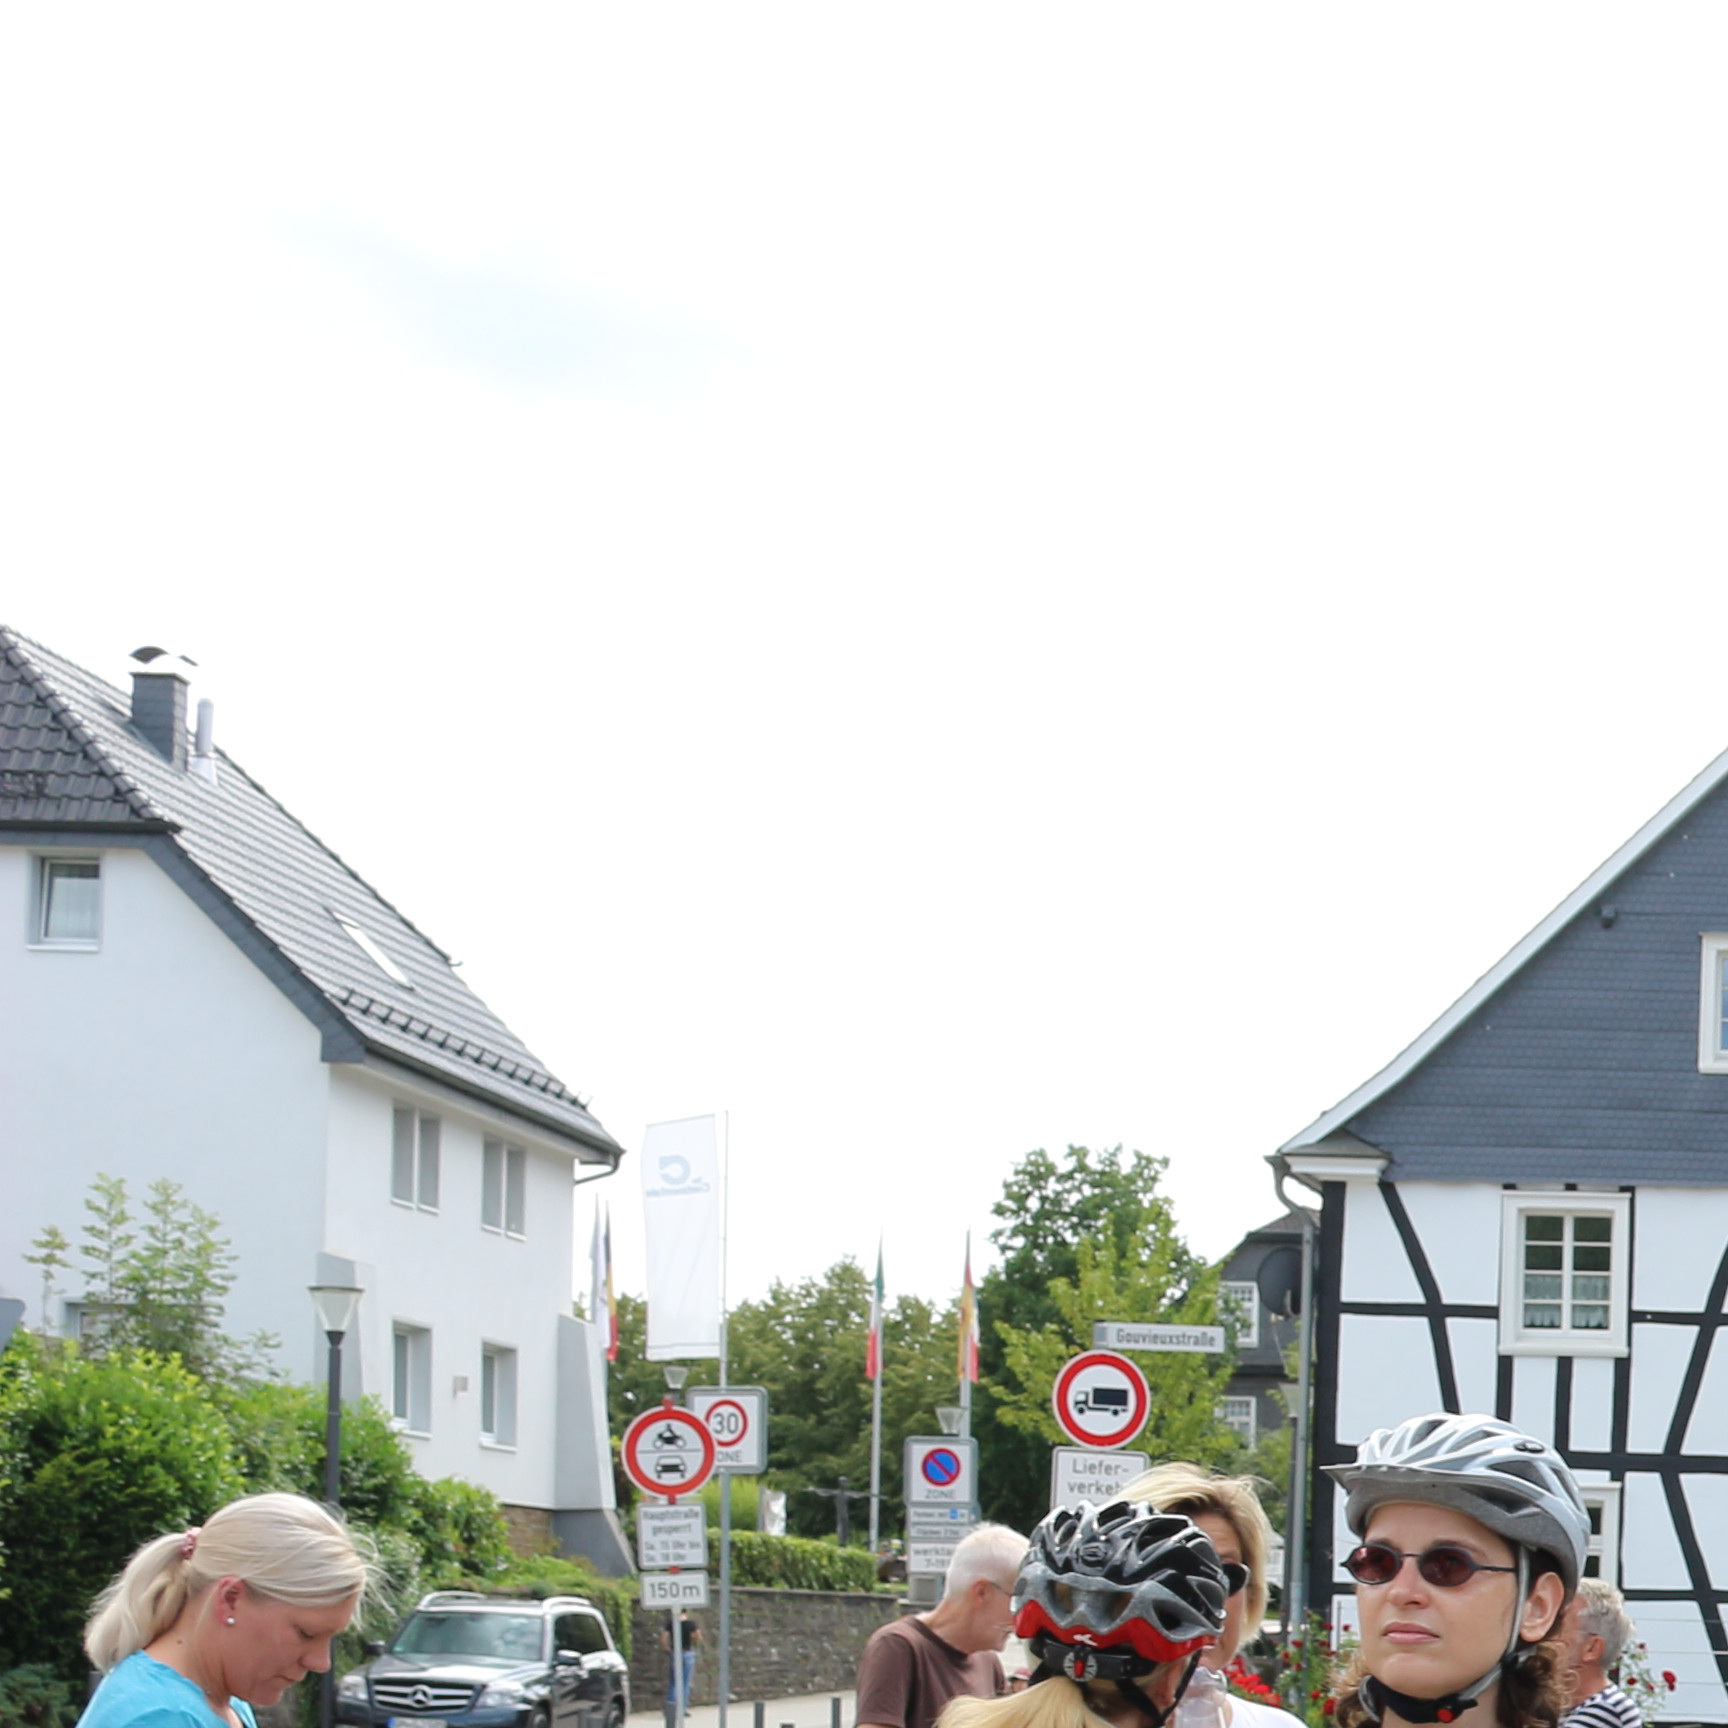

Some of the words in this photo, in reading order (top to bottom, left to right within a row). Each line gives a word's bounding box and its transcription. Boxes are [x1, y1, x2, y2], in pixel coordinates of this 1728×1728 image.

[1116, 1328, 1217, 1347] Gouvieuxstraße
[712, 1412, 740, 1435] 30
[716, 1450, 743, 1463] ONE
[1072, 1457, 1130, 1476] Liefer-
[924, 1489, 956, 1501] ZONE
[648, 1581, 680, 1599] 150
[682, 1585, 700, 1599] m
